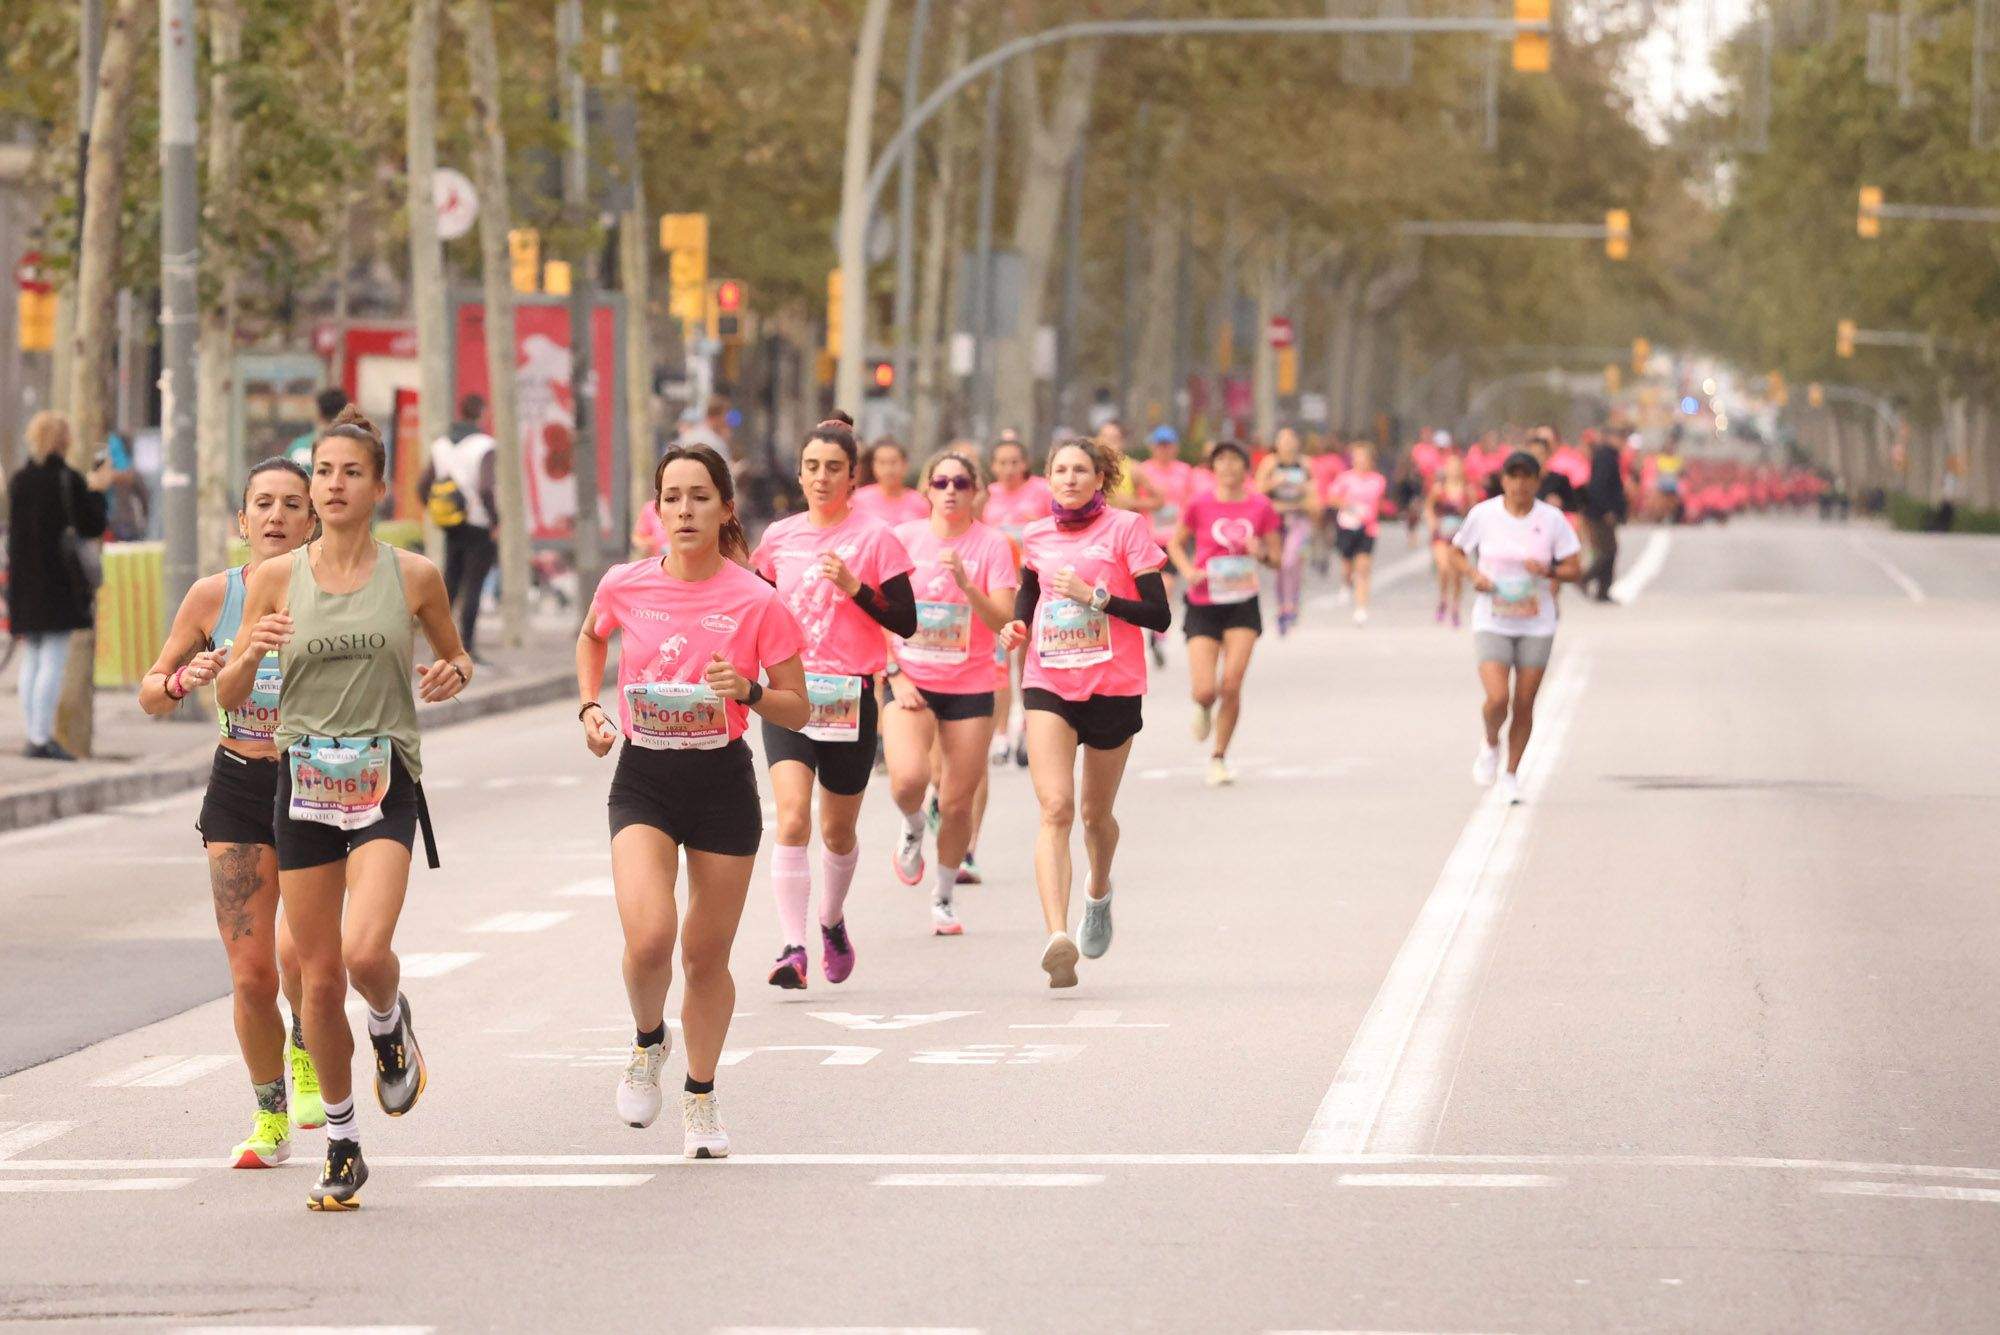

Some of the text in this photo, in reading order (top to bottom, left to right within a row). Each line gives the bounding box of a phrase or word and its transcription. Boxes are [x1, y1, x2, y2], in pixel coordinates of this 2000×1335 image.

[630, 607, 671, 622] OYSHO
[1059, 627, 1086, 641] 016
[307, 632, 386, 655] OYSHO
[256, 707, 279, 722] 01
[657, 709, 695, 723] 016
[323, 776, 357, 794] 016
